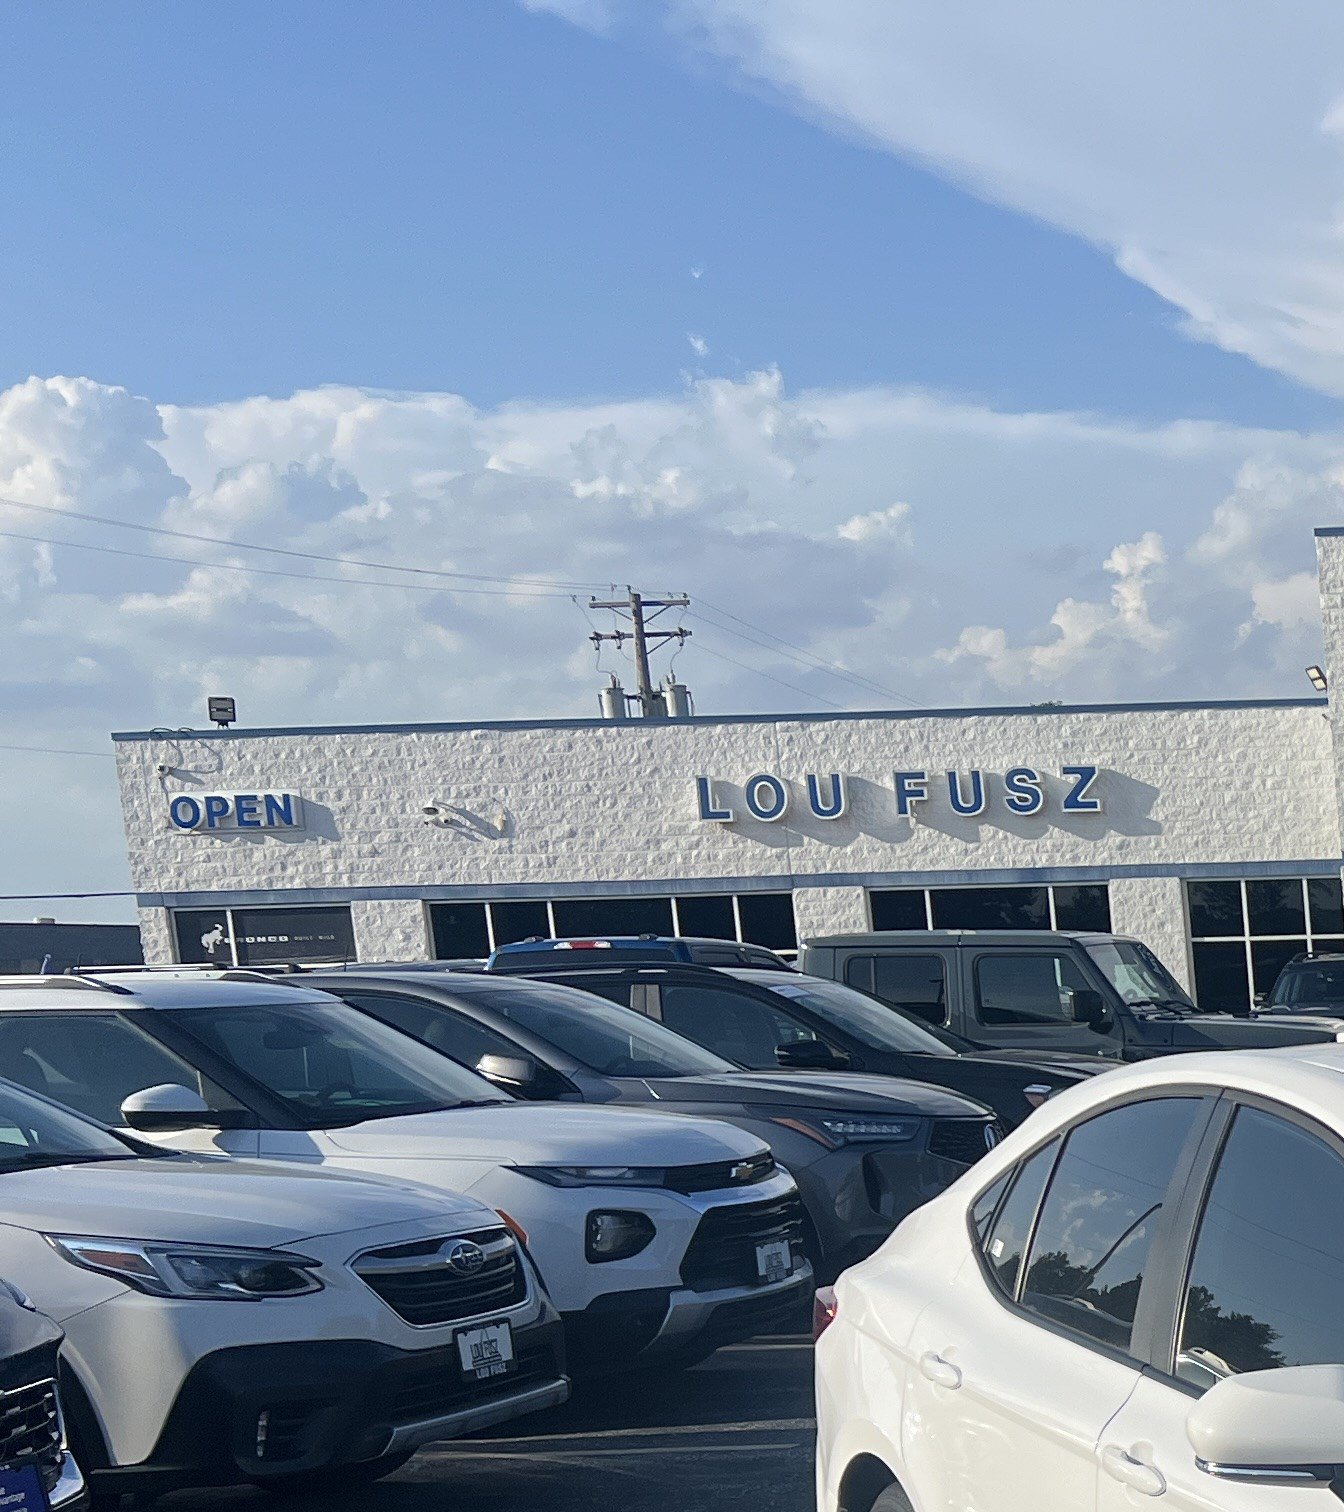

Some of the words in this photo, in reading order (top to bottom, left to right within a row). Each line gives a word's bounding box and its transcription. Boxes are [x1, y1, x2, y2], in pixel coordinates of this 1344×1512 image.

[170, 792, 295, 831] OPEN
[696, 773, 845, 823] LOU
[894, 765, 1101, 816] FUSZ
